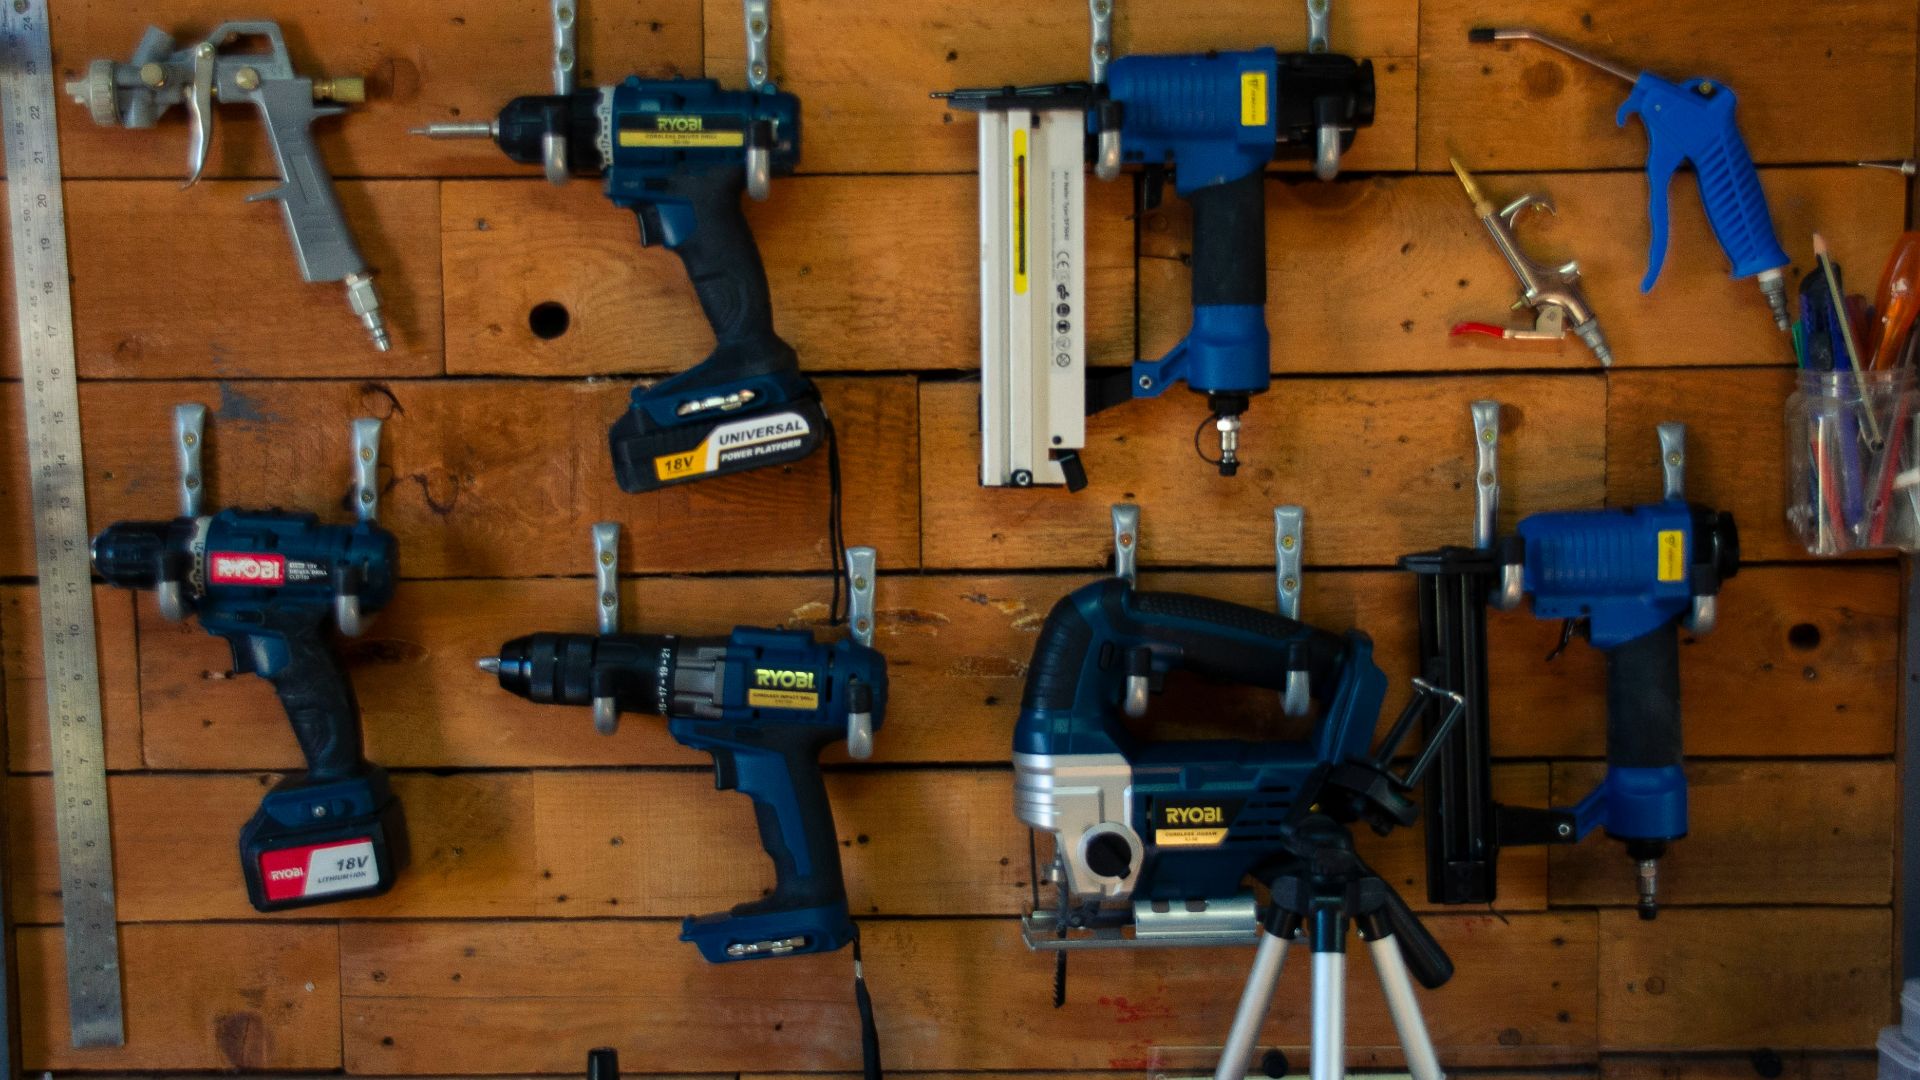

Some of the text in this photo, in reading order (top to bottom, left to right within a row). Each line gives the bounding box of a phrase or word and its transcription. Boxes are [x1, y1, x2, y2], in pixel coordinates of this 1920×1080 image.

[657, 117, 703, 132] RYOBI
[718, 420, 803, 446] UNIVERSAL
[720, 438, 802, 463] POWER PLATFORM
[664, 456, 695, 472] 18V
[217, 557, 281, 579] RYOBI
[756, 669, 815, 689] RYOBI
[1165, 806, 1222, 823] RYOBI
[336, 855, 369, 872] 18V
[270, 867, 304, 881] RYOBI
